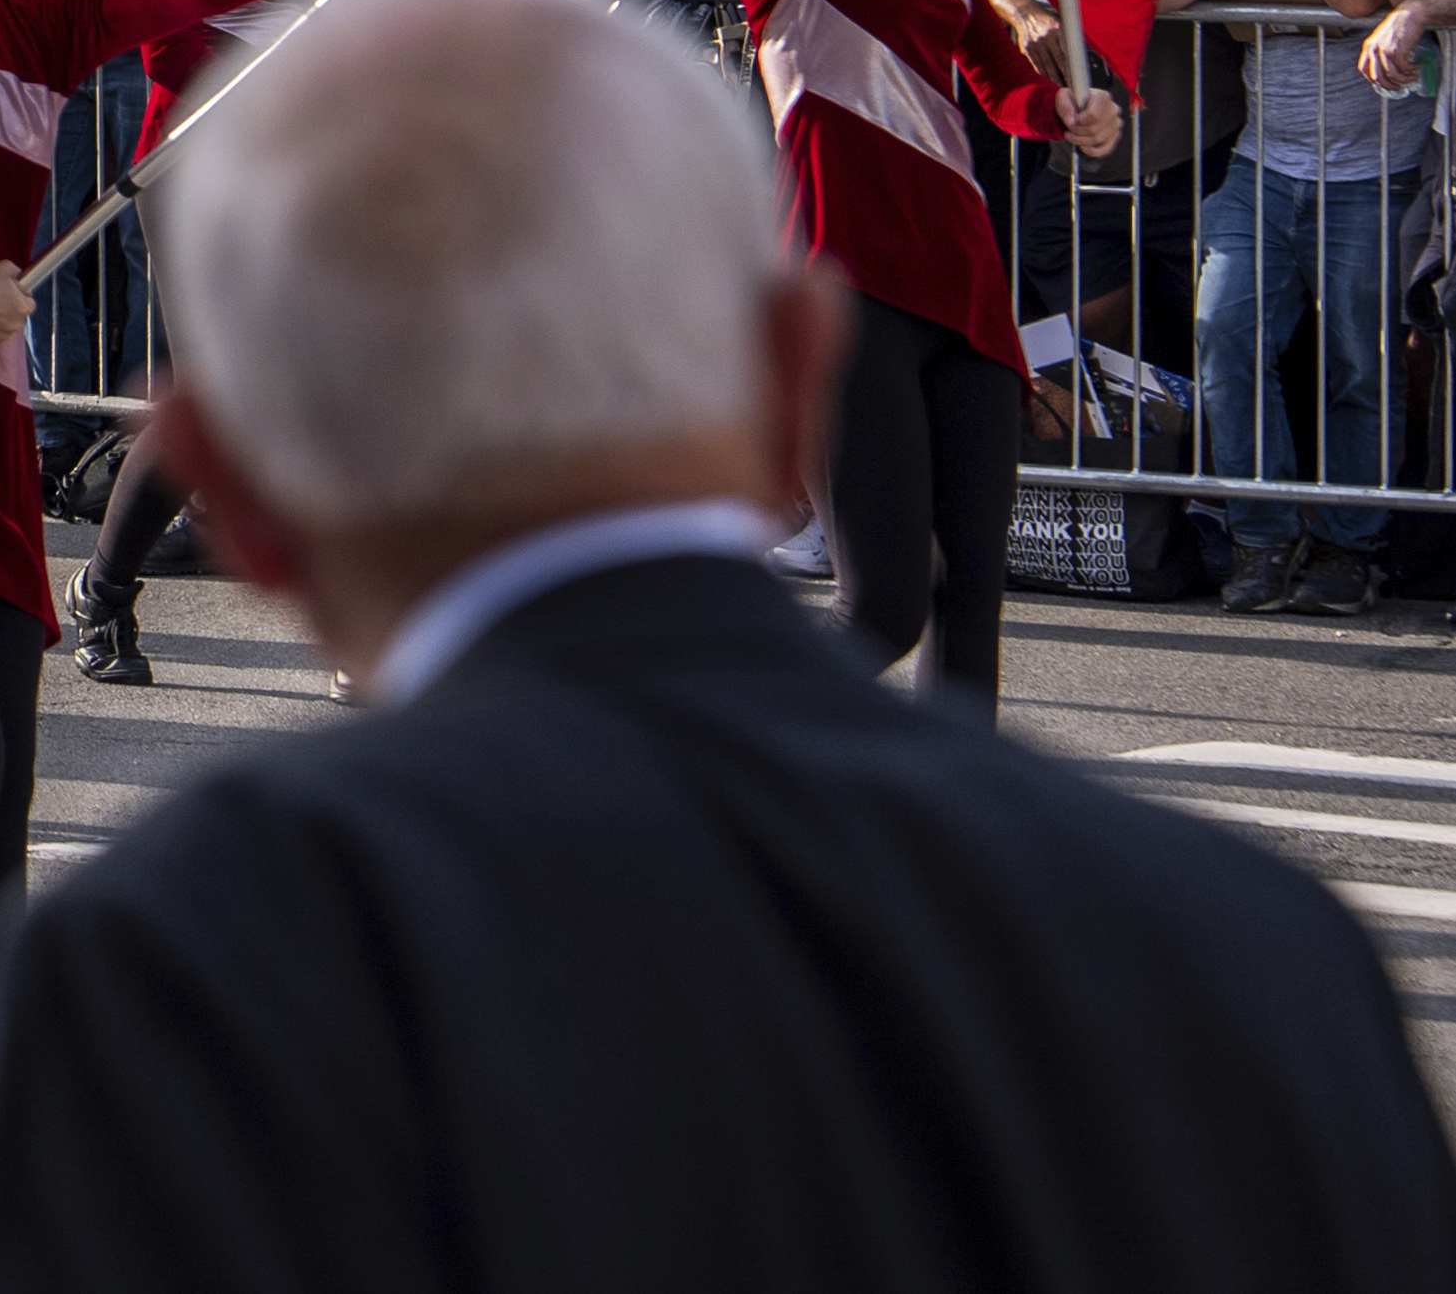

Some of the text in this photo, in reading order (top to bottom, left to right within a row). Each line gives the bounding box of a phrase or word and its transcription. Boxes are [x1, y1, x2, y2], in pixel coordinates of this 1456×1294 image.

[1076, 492, 1124, 510] YOU
[1076, 507, 1126, 525] YOU
[1008, 521, 1124, 541] HANK YOU
[1007, 535, 1127, 555] HANK YOU
[1076, 553, 1128, 570] YOU
[1077, 568, 1131, 585] YOU
